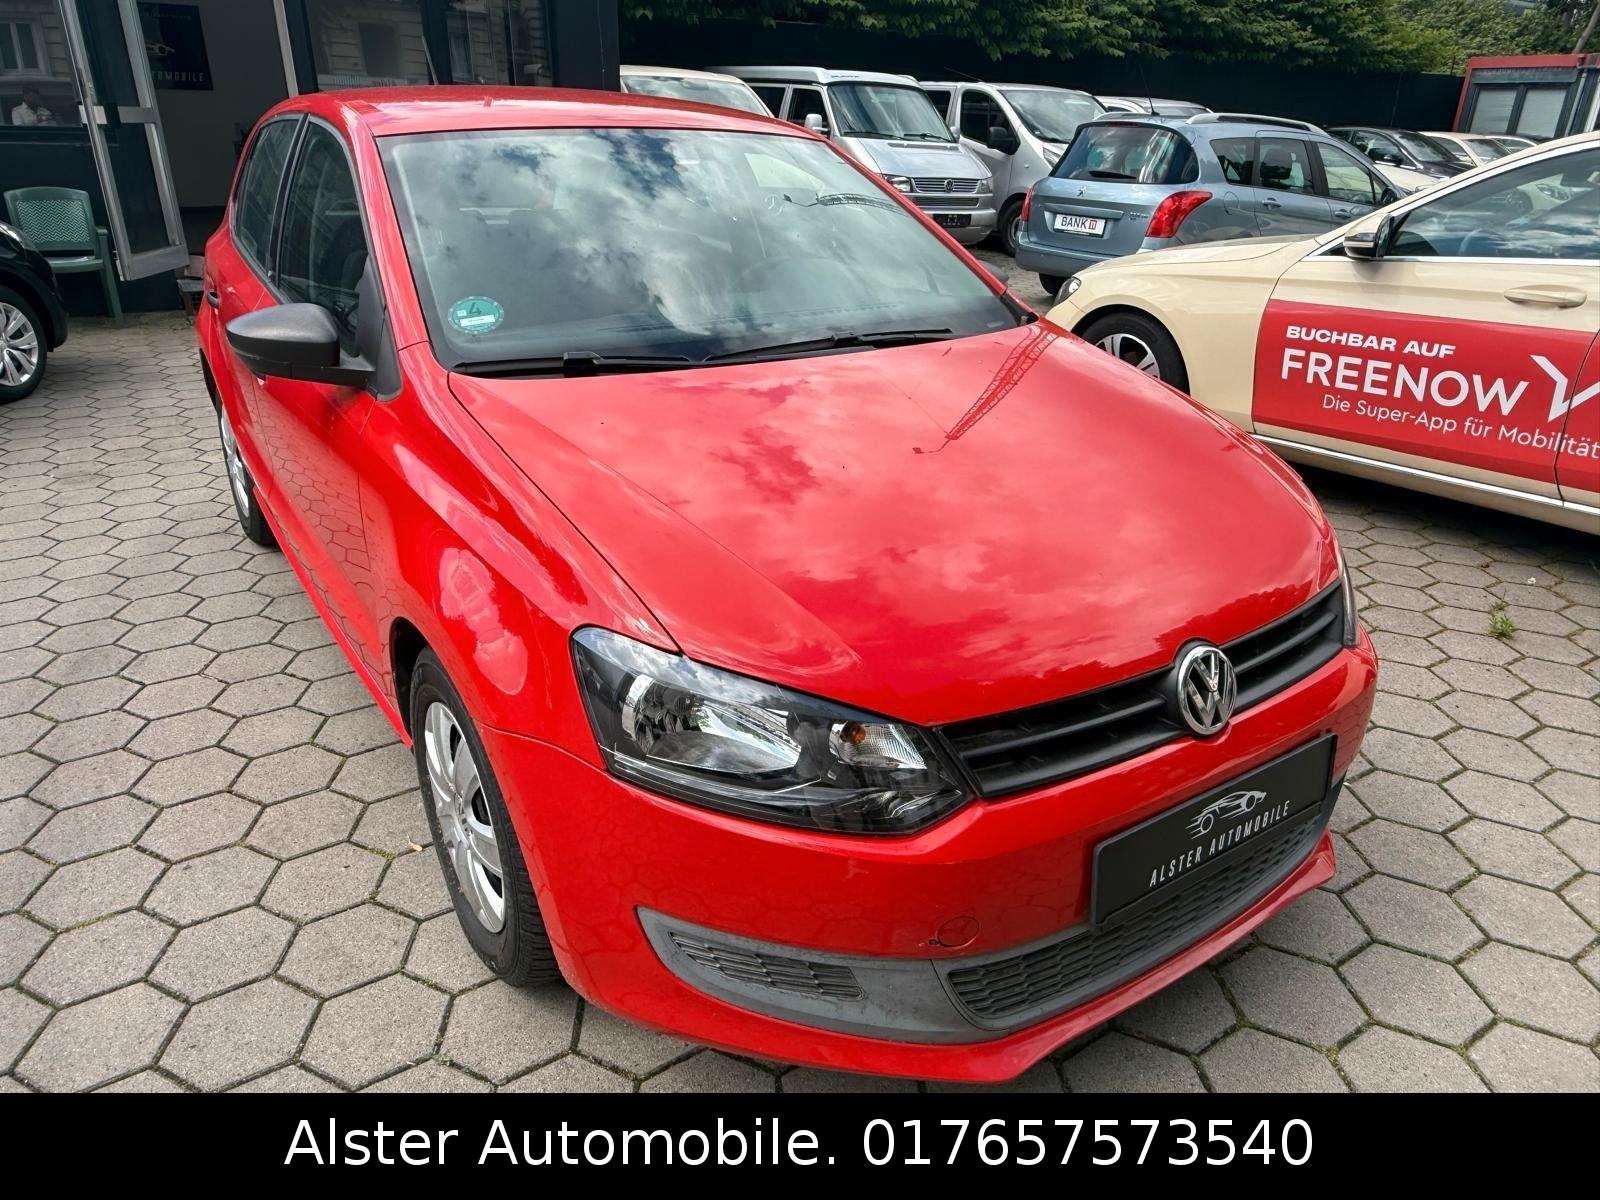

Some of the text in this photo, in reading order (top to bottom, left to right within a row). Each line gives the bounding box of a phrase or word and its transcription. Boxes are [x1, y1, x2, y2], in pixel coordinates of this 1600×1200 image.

[1061, 216, 1088, 230] BANK
[1286, 325, 1457, 359] BUCHBAR AUF
[1281, 347, 1530, 416] FREENOW
[1322, 394, 1600, 459] Die Super-App für Mobilität
[1150, 800, 1290, 887] ALSTER AUTOMOBILE
